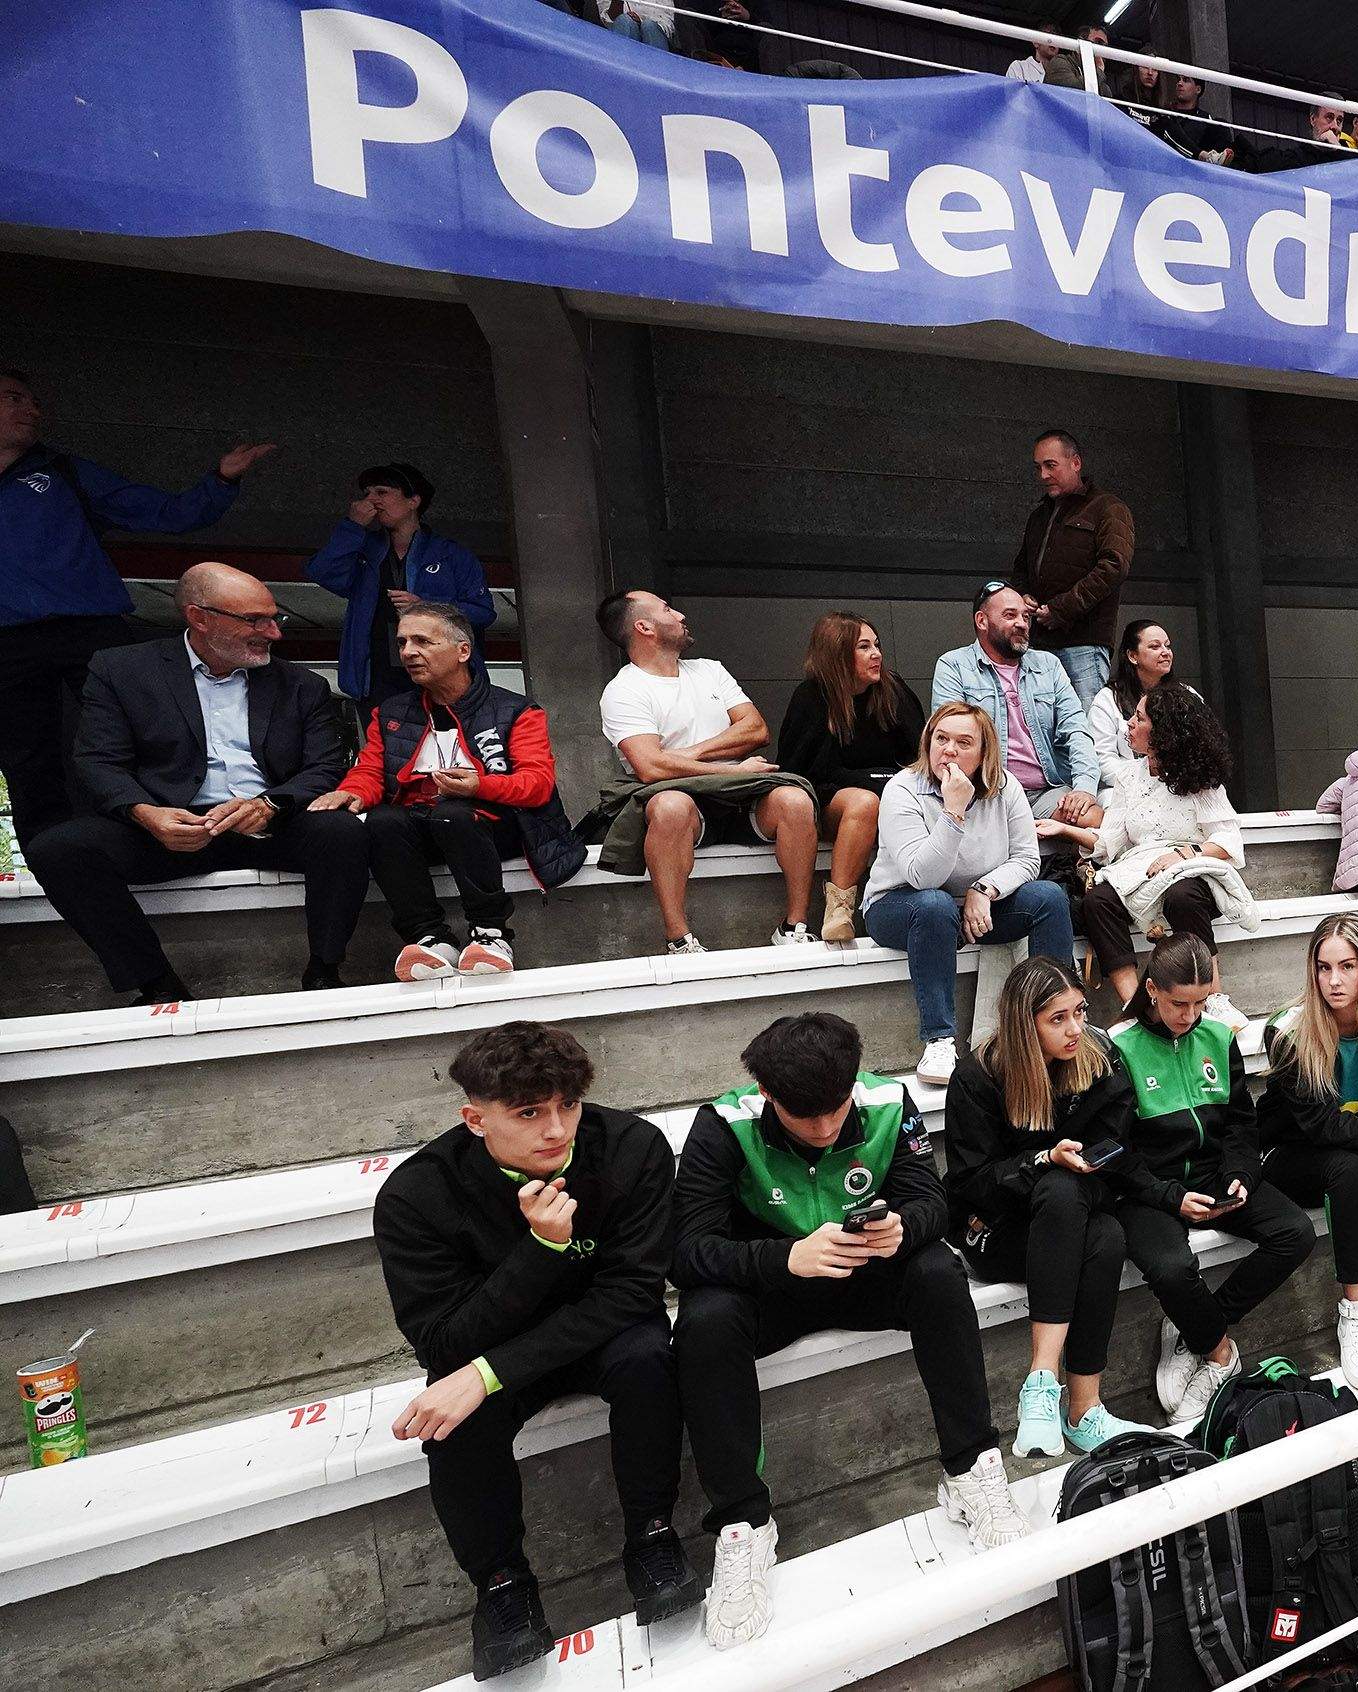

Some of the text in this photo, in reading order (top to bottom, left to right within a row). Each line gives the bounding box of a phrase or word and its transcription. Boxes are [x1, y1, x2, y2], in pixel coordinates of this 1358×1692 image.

[357, 1156, 389, 1175] 72
[36, 1407, 77, 1432] PRINGLES
[287, 1401, 328, 1430] 72
[554, 1628, 595, 1664] 70
